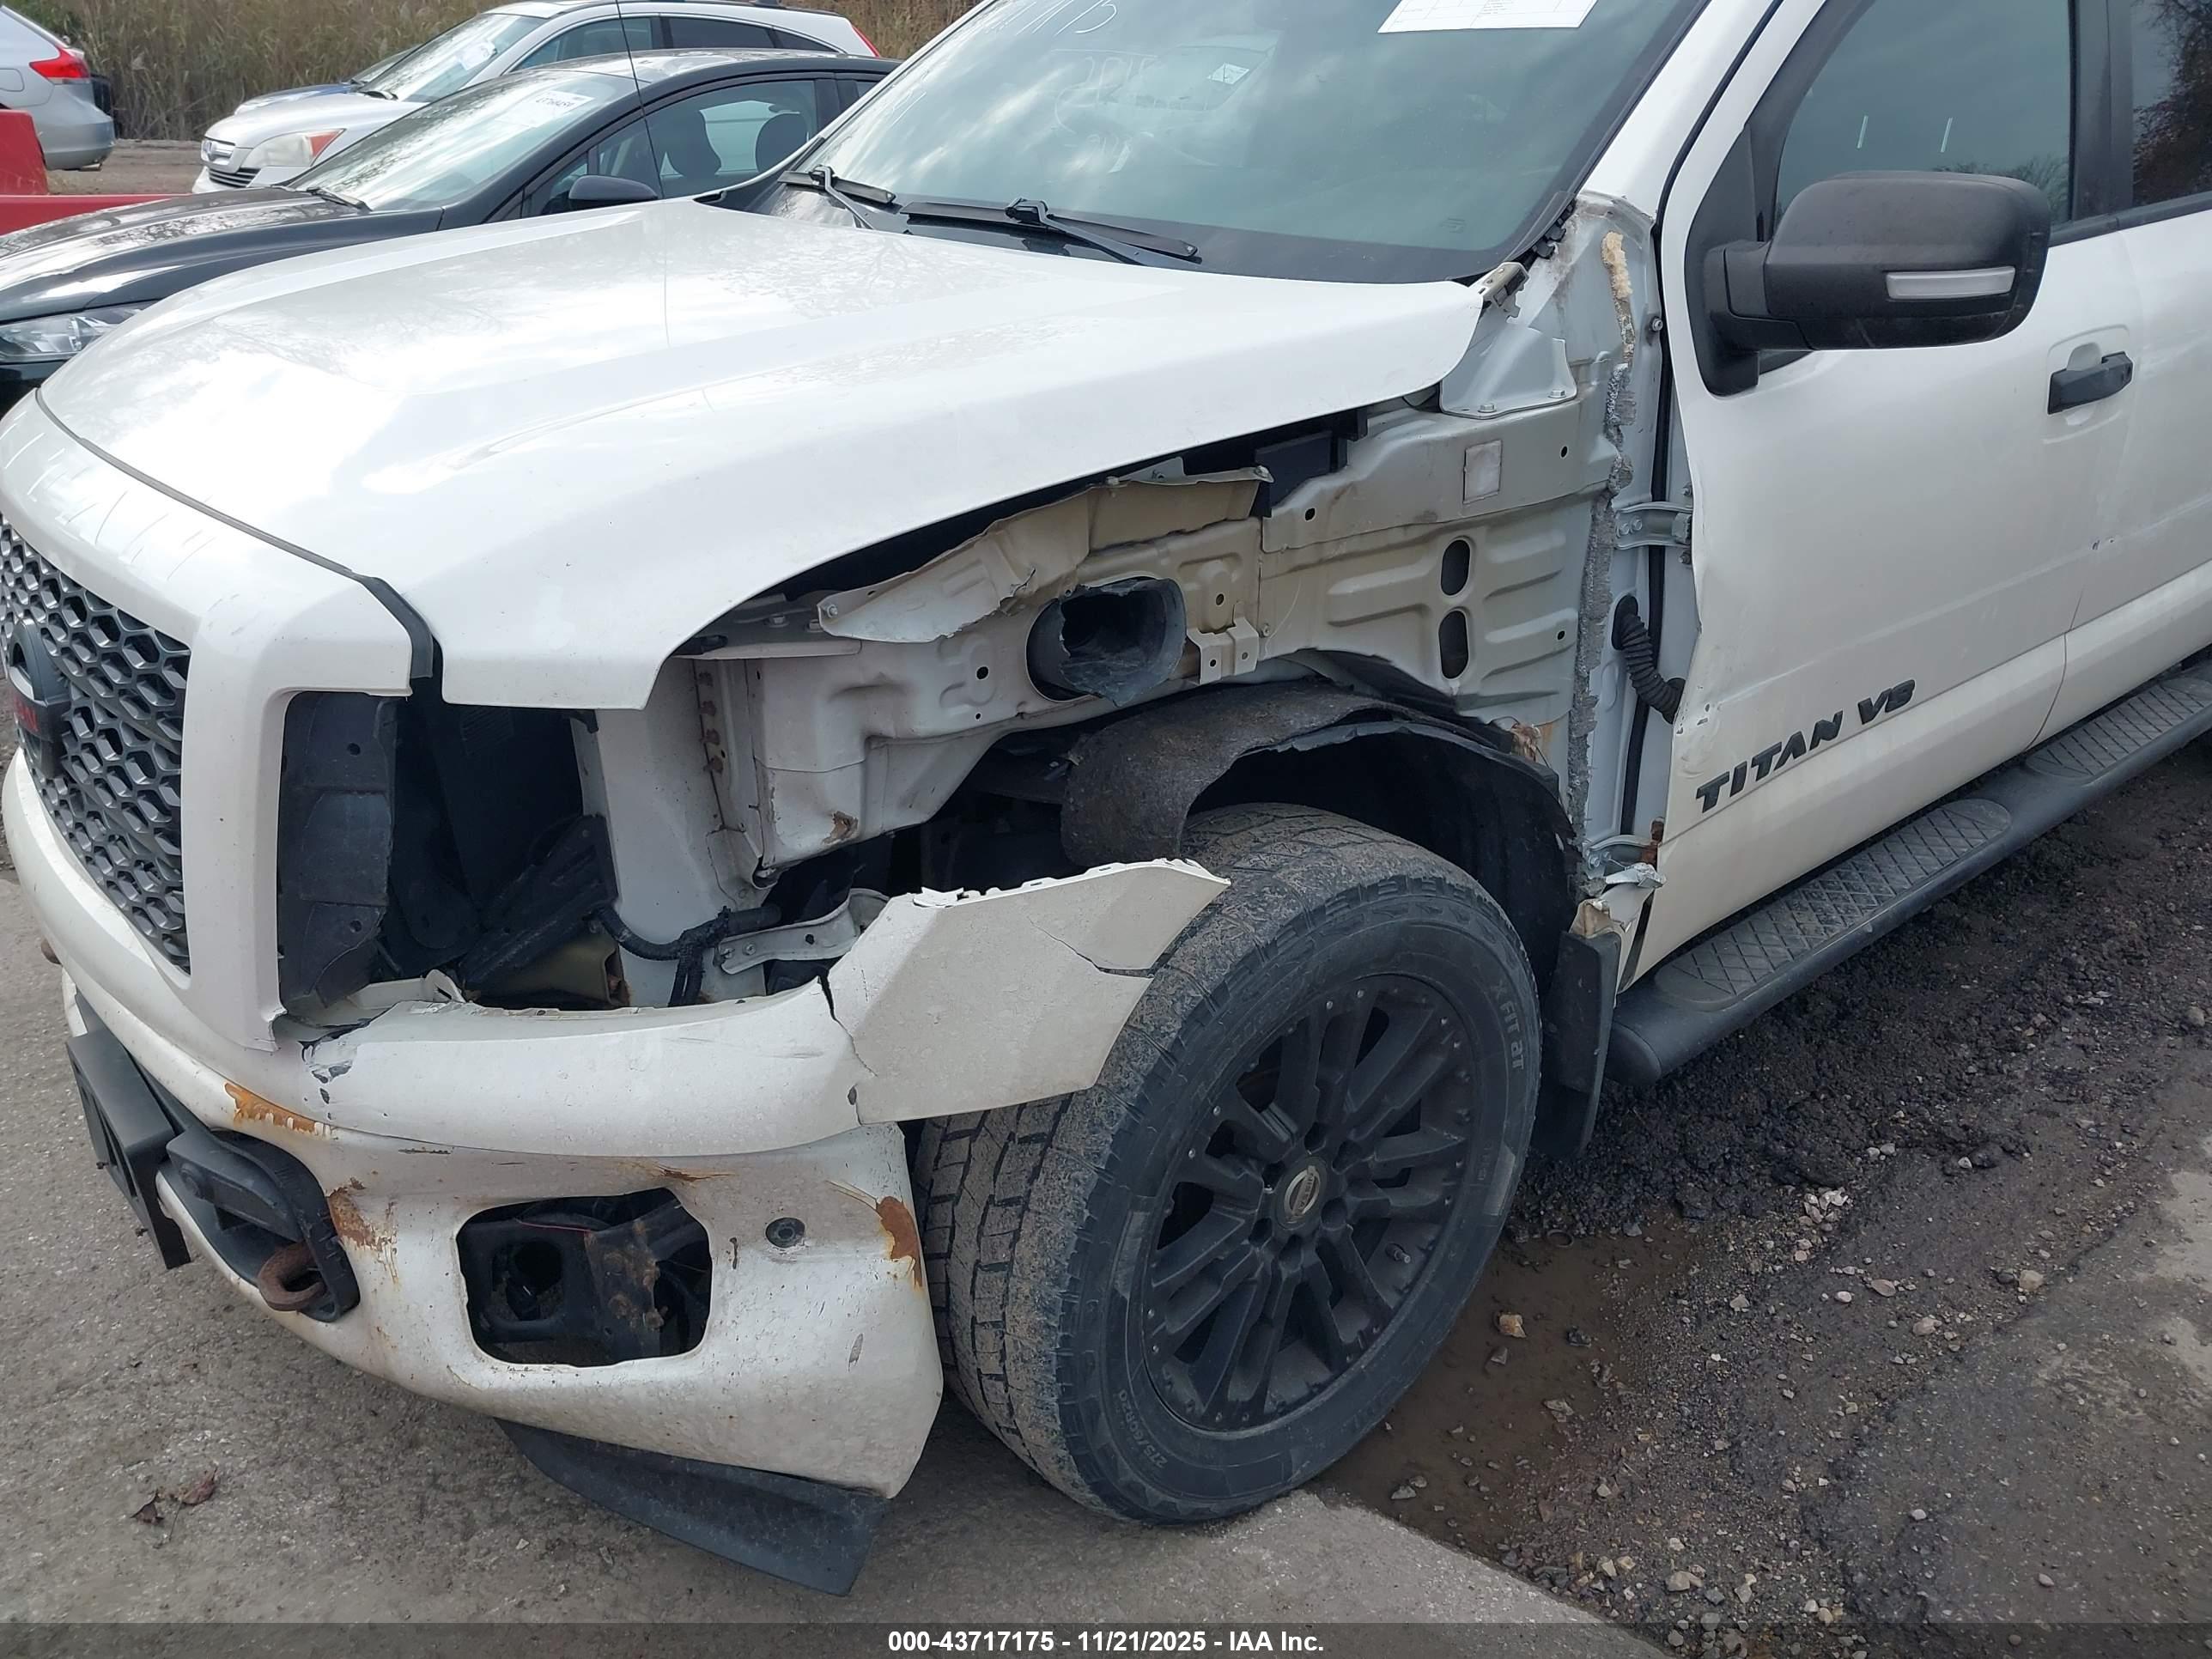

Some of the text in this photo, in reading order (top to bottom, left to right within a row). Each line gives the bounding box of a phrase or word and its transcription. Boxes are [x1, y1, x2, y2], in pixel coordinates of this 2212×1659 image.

[1695, 678, 1916, 814] TITAN V8
[1499, 1000, 1521, 1033] FIT
